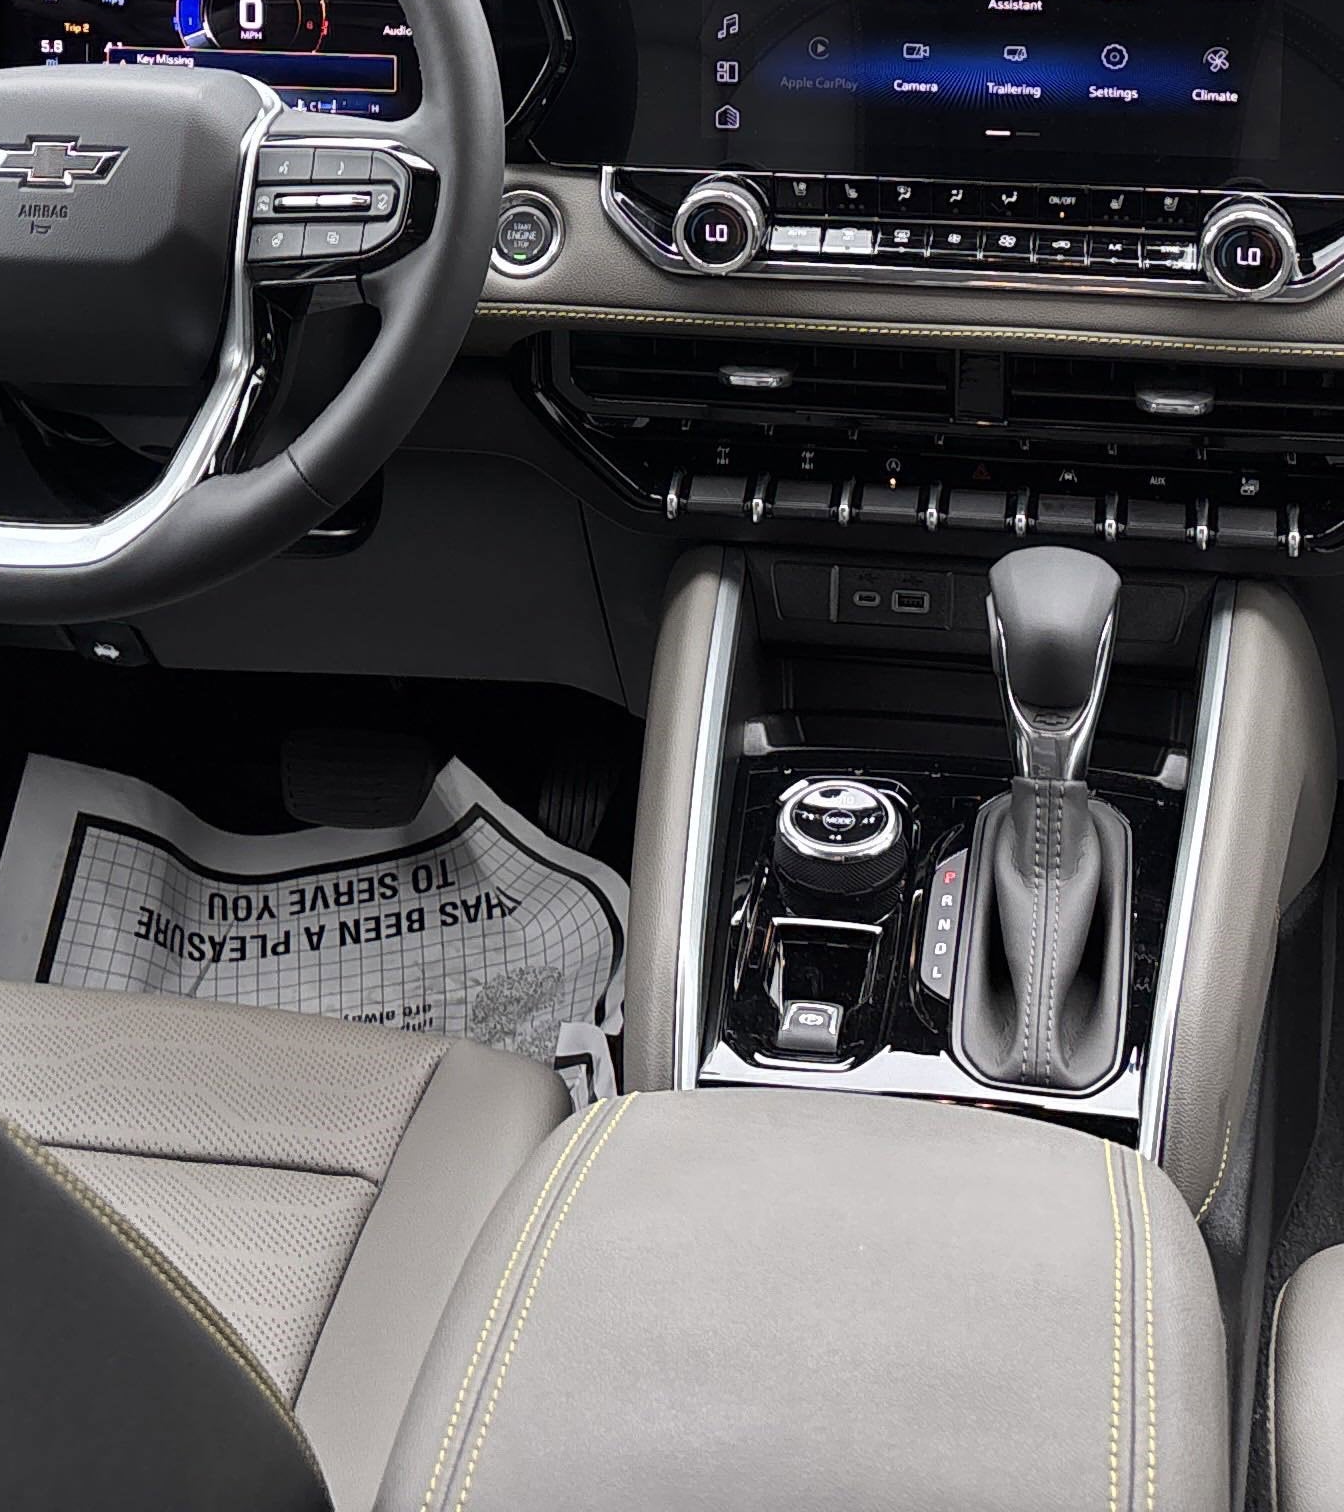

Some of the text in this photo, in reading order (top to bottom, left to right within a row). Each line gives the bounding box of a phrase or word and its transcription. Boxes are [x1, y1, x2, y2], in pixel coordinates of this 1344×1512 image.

[64, 22, 90, 34] Trip 2
[240, 31, 263, 40] MPH
[136, 54, 194, 67] Key Missing
[780, 76, 858, 92] Apple CarPlay
[893, 79, 938, 93] Camera
[987, 82, 1042, 98] Trailering
[1089, 86, 1139, 102] Settings
[1192, 89, 1238, 102] Climate
[1048, 196, 1077, 206] ON/OFF
[18, 204, 68, 218] AIRBAG
[513, 222, 532, 230] START
[507, 231, 536, 241] ENGINE
[705, 224, 728, 242] LO
[513, 241, 530, 249] STOP
[1237, 247, 1261, 266] LO
[1150, 476, 1166, 486] AUX
[943, 871, 956, 884] P
[208, 857, 456, 922] TO SERVE YOU
[941, 894, 953, 906] R
[439, 891, 507, 927] HAS
[339, 907, 425, 947] BEEN
[938, 919, 950, 930] N
[134, 906, 291, 963] PLEASURE
[304, 926, 325, 950] A
[935, 942, 947, 955] D
[932, 966, 942, 978] L
